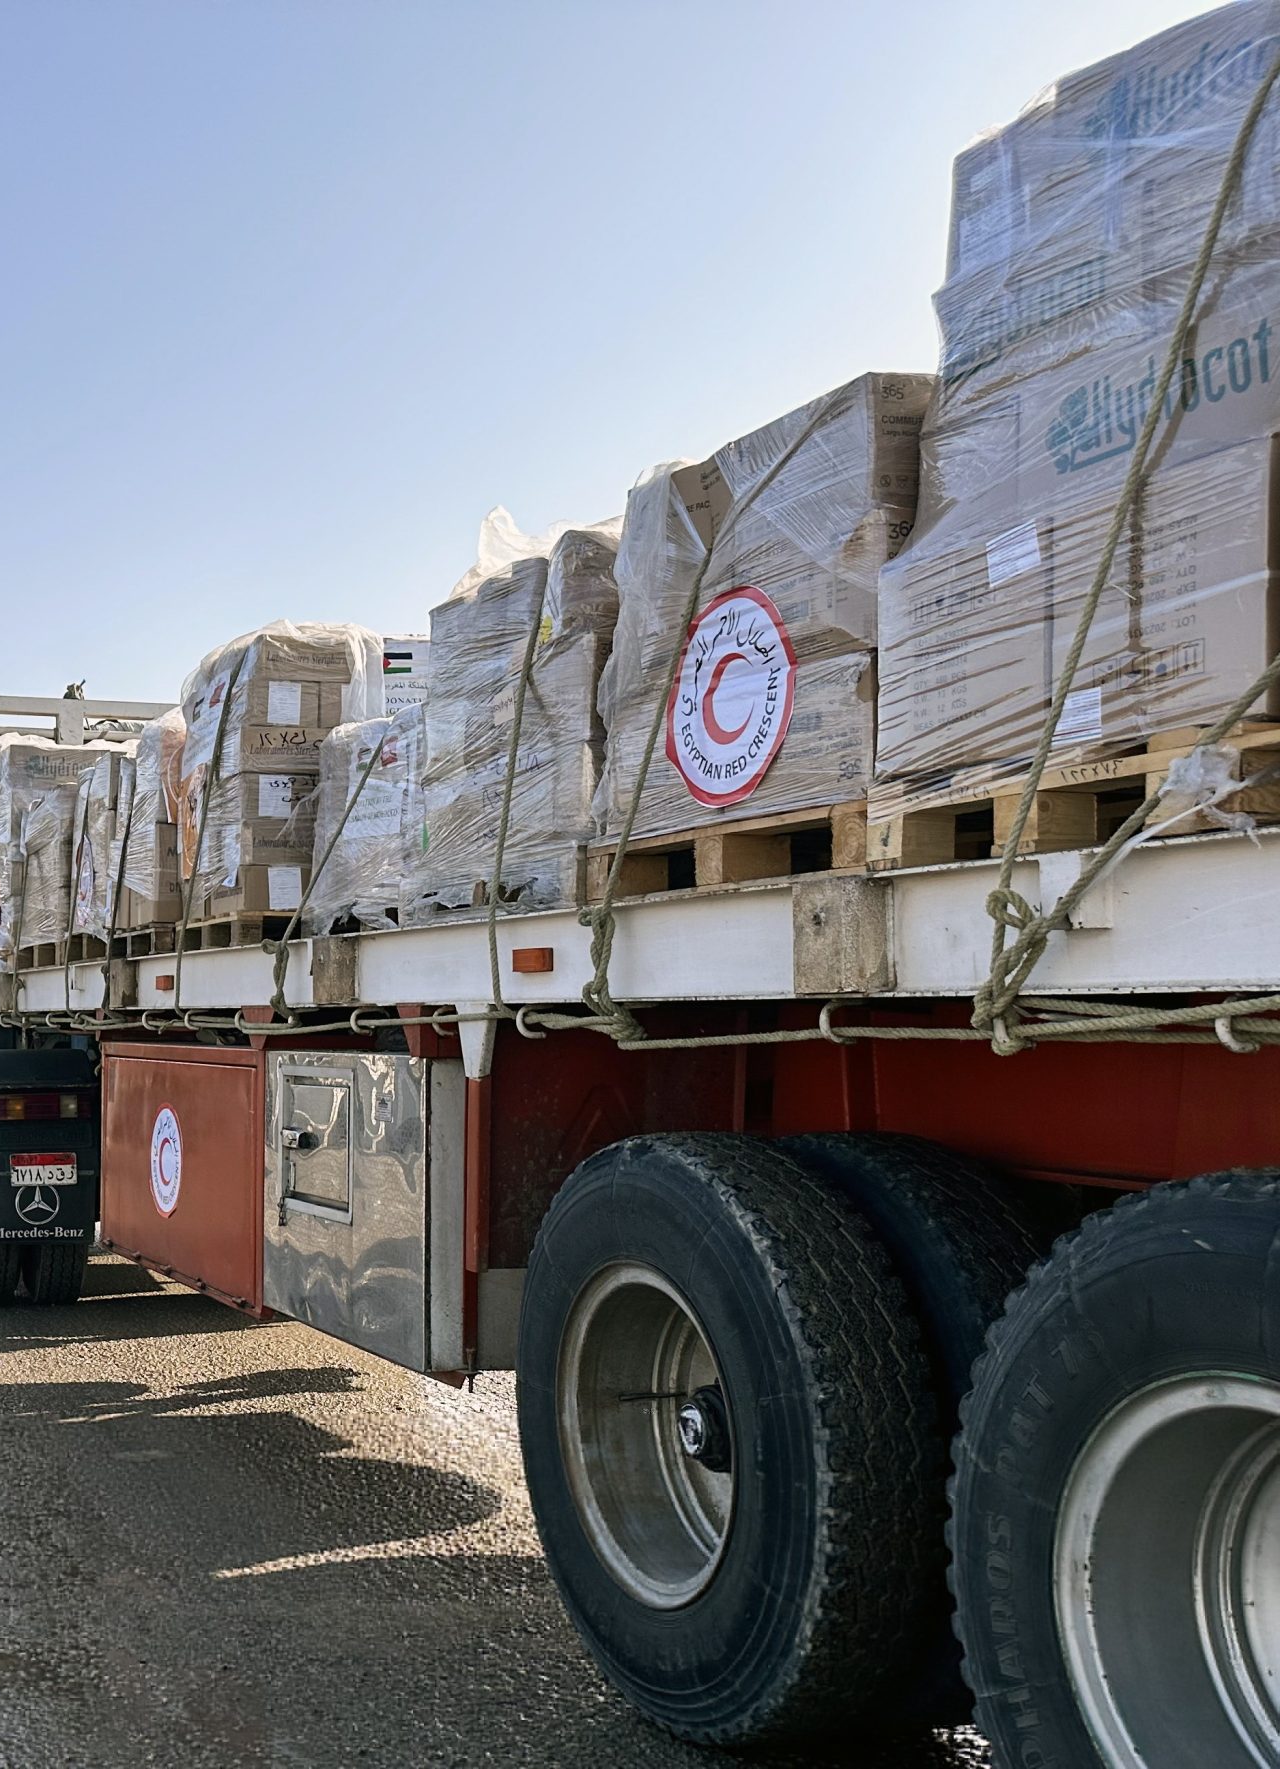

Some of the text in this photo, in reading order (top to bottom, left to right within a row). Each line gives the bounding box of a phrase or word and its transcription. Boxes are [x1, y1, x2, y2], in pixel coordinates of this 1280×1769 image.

[681, 725, 722, 780] EGYPTIAN
[725, 755, 747, 780] RED
[748, 667, 781, 759] CRESCENT
